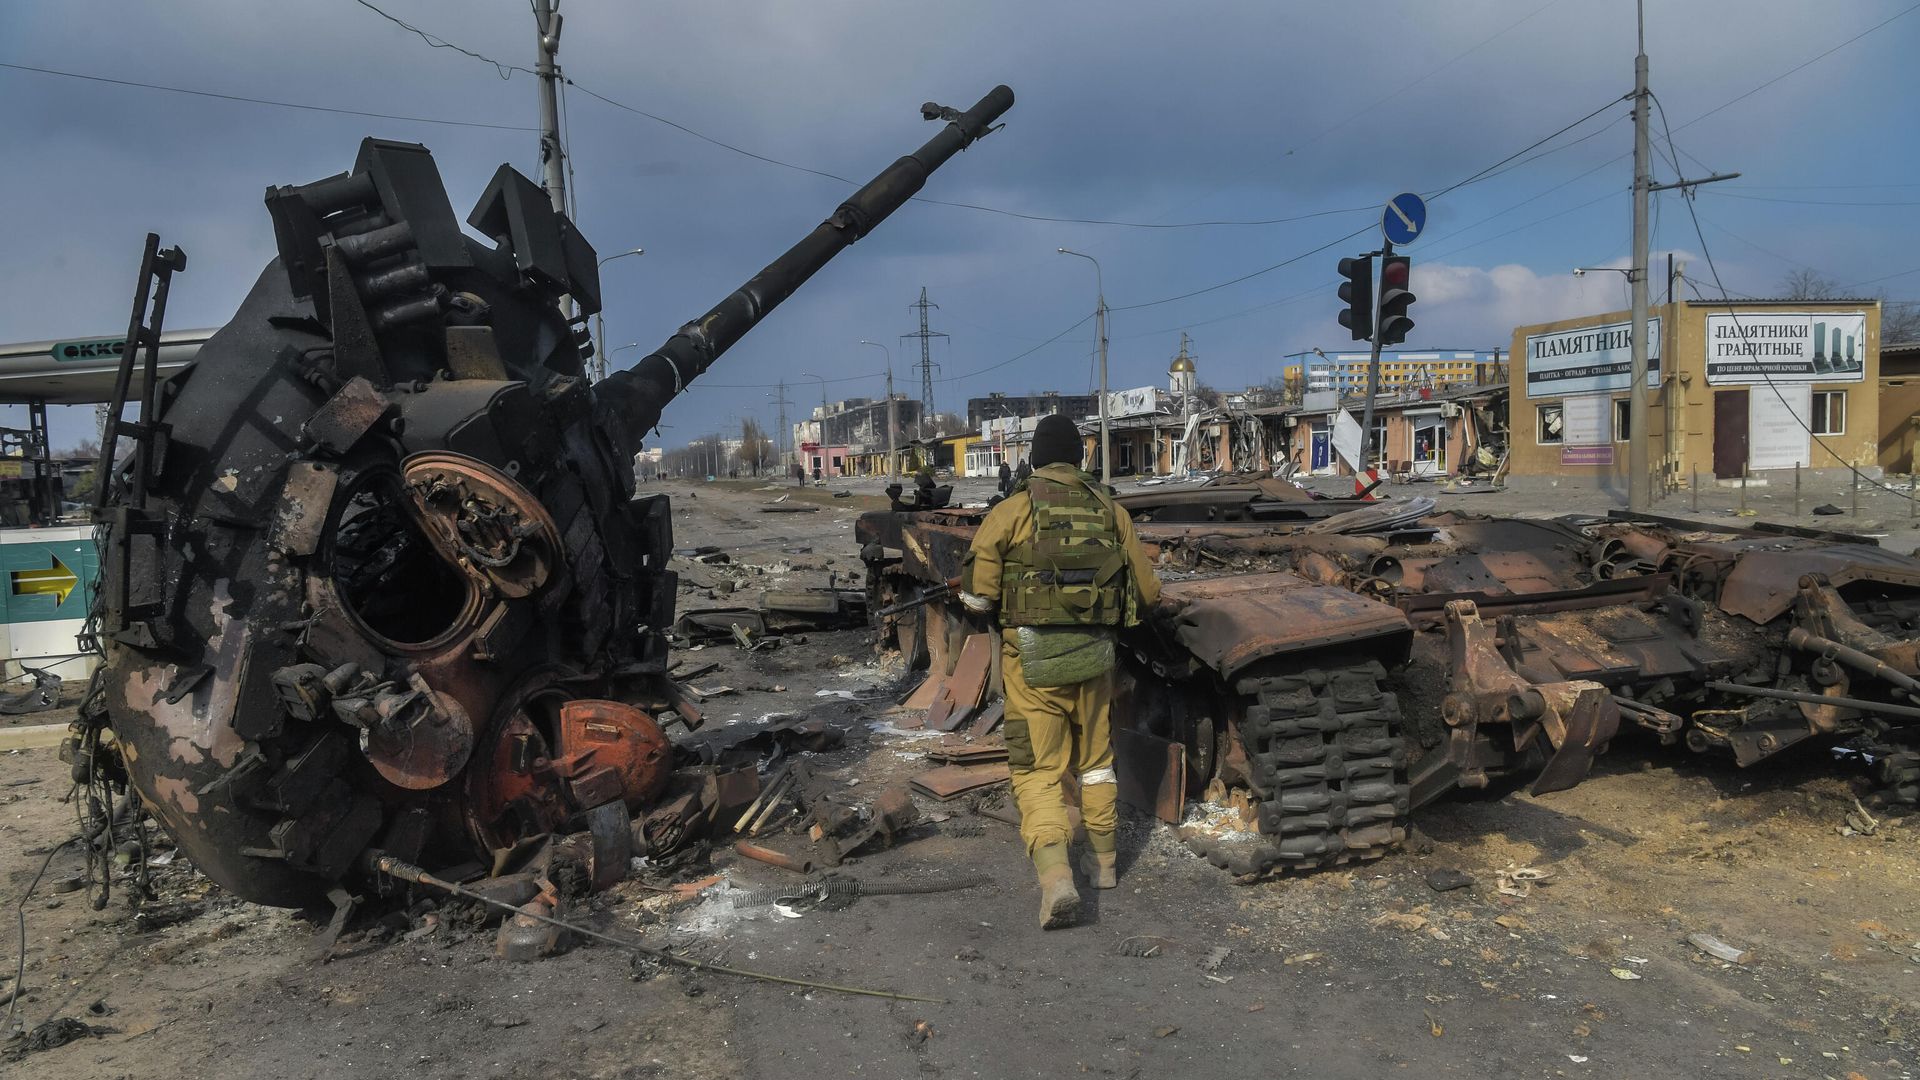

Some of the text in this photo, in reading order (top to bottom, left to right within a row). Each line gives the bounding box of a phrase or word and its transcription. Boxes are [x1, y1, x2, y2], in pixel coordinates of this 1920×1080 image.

[1716, 325, 1808, 338] ПАМЯТНИКИ
[1535, 326, 1650, 358] ПАМЯТНИК
[1717, 343, 1803, 356] ГРАНИТНЫЕ
